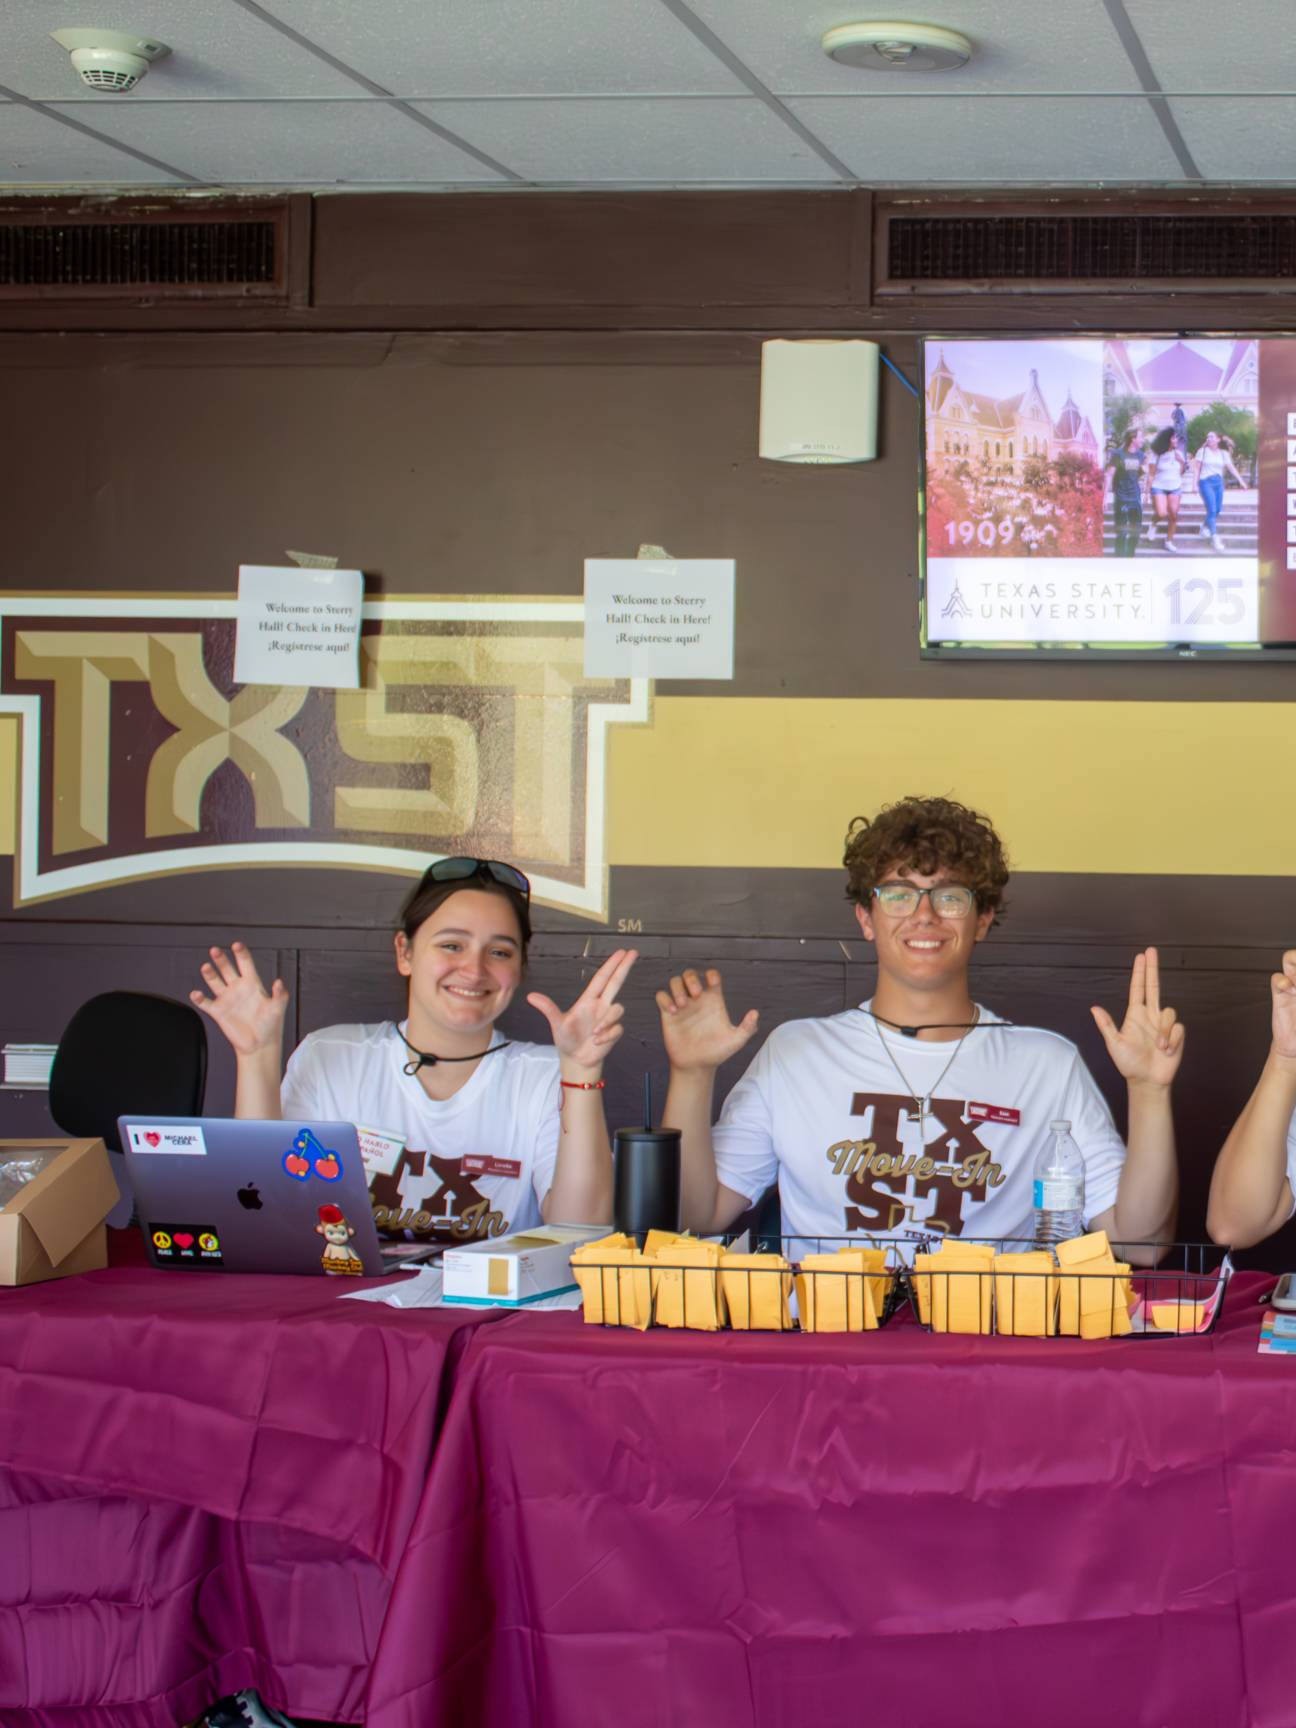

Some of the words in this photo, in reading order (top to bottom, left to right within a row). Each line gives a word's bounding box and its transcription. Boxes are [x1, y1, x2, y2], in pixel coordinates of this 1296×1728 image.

[944, 520, 1015, 545] 1909
[980, 583, 1057, 599] TEXAS
[1072, 583, 1143, 598] STATE
[612, 595, 658, 606] Welcome
[661, 596, 671, 606] to
[674, 595, 706, 608] Sterry
[1163, 578, 1246, 625] 125
[265, 603, 310, 614] Welcome
[312, 605, 323, 614] to
[325, 604, 354, 618] Sterry
[258, 622, 284, 633] Hall!
[286, 622, 320, 633] Check
[321, 622, 331, 633] in
[606, 614, 631, 625] Hall!
[634, 614, 667, 625] Check
[670, 614, 680, 625] in
[683, 614, 711, 625] Here!
[15, 631, 616, 866] TXST
[617, 918, 642, 933] SM
[850, 1092, 992, 1163] TX
[133, 1133, 140, 1145] I
[364, 1138, 390, 1150] HABLO
[827, 1140, 1007, 1189] Move-In
[845, 1174, 986, 1237] ST
[371, 1200, 510, 1240] ove-In
